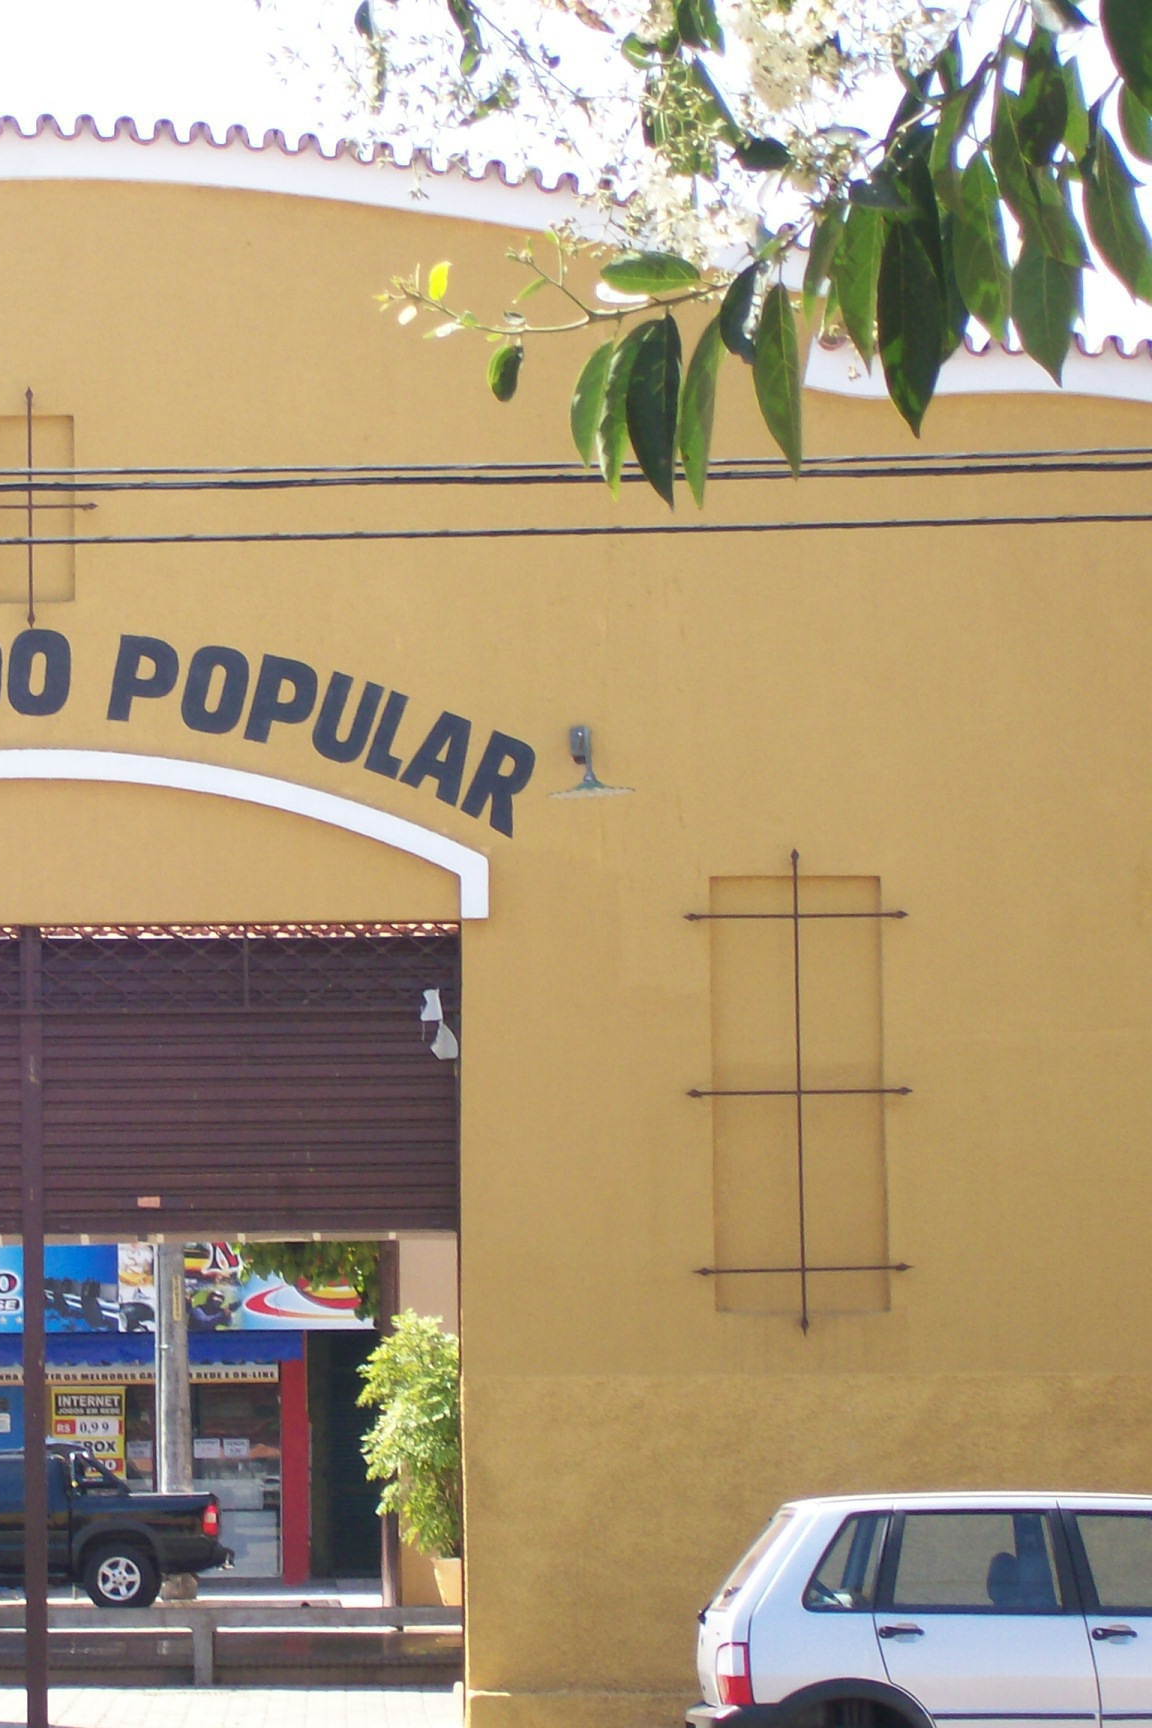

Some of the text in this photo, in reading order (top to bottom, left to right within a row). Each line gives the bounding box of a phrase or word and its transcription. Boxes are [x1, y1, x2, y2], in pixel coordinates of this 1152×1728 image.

[106, 633, 536, 838] POPULAR
[80, 1372, 136, 1380] MELHORES
[233, 1370, 274, 1379] ON-LINE
[57, 1395, 120, 1407] INTERNET
[83, 1440, 116, 1452] ROX
